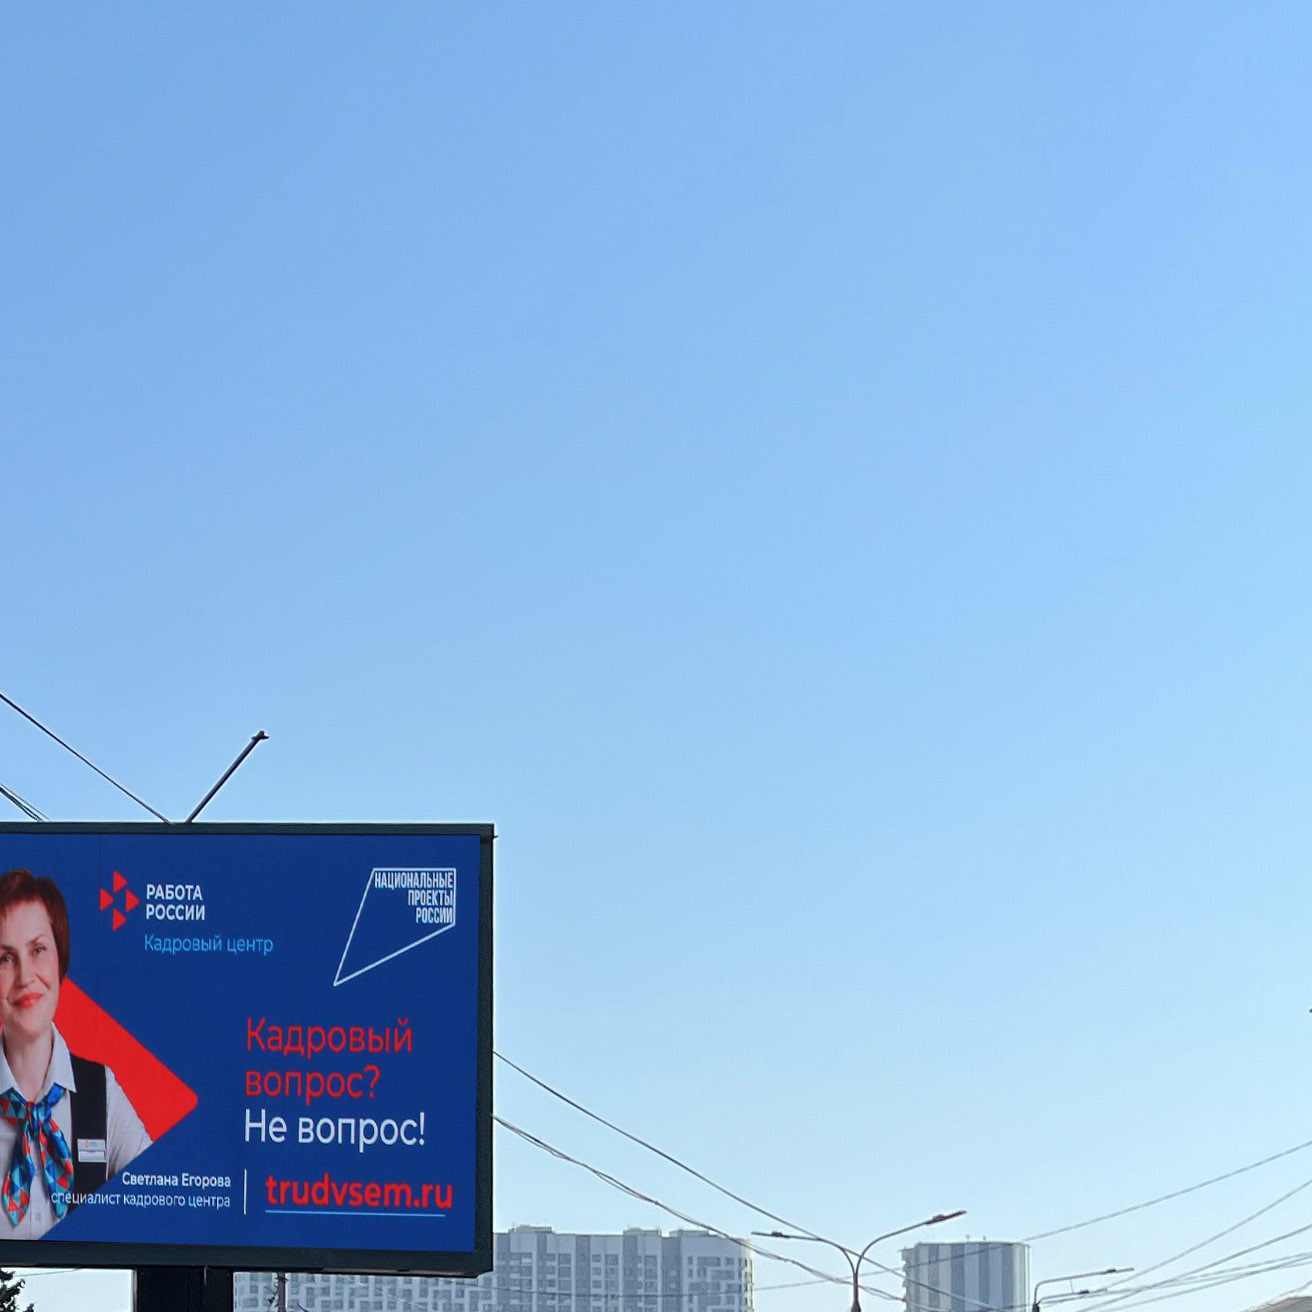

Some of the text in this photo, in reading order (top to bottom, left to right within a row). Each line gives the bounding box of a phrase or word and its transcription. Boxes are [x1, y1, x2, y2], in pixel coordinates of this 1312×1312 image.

[374, 871, 454, 890] НАЦИОНАЛЬНЫЕ
[145, 883, 203, 901] РАБОТА
[407, 889, 454, 906] ПРОЕКТЫ
[145, 903, 206, 921] РОССИИ
[415, 907, 454, 924] РОССИИ
[144, 932, 274, 956] Кадровый центр
[246, 1016, 414, 1060] Кадровый
[244, 1064, 382, 1105] вопрос?
[244, 1108, 426, 1153] Не вопрос!
[122, 1171, 232, 1191] Светлана Егорова
[265, 1171, 454, 1210] trudvsem.ru
[51, 1191, 231, 1211] специалист кадрового центра
